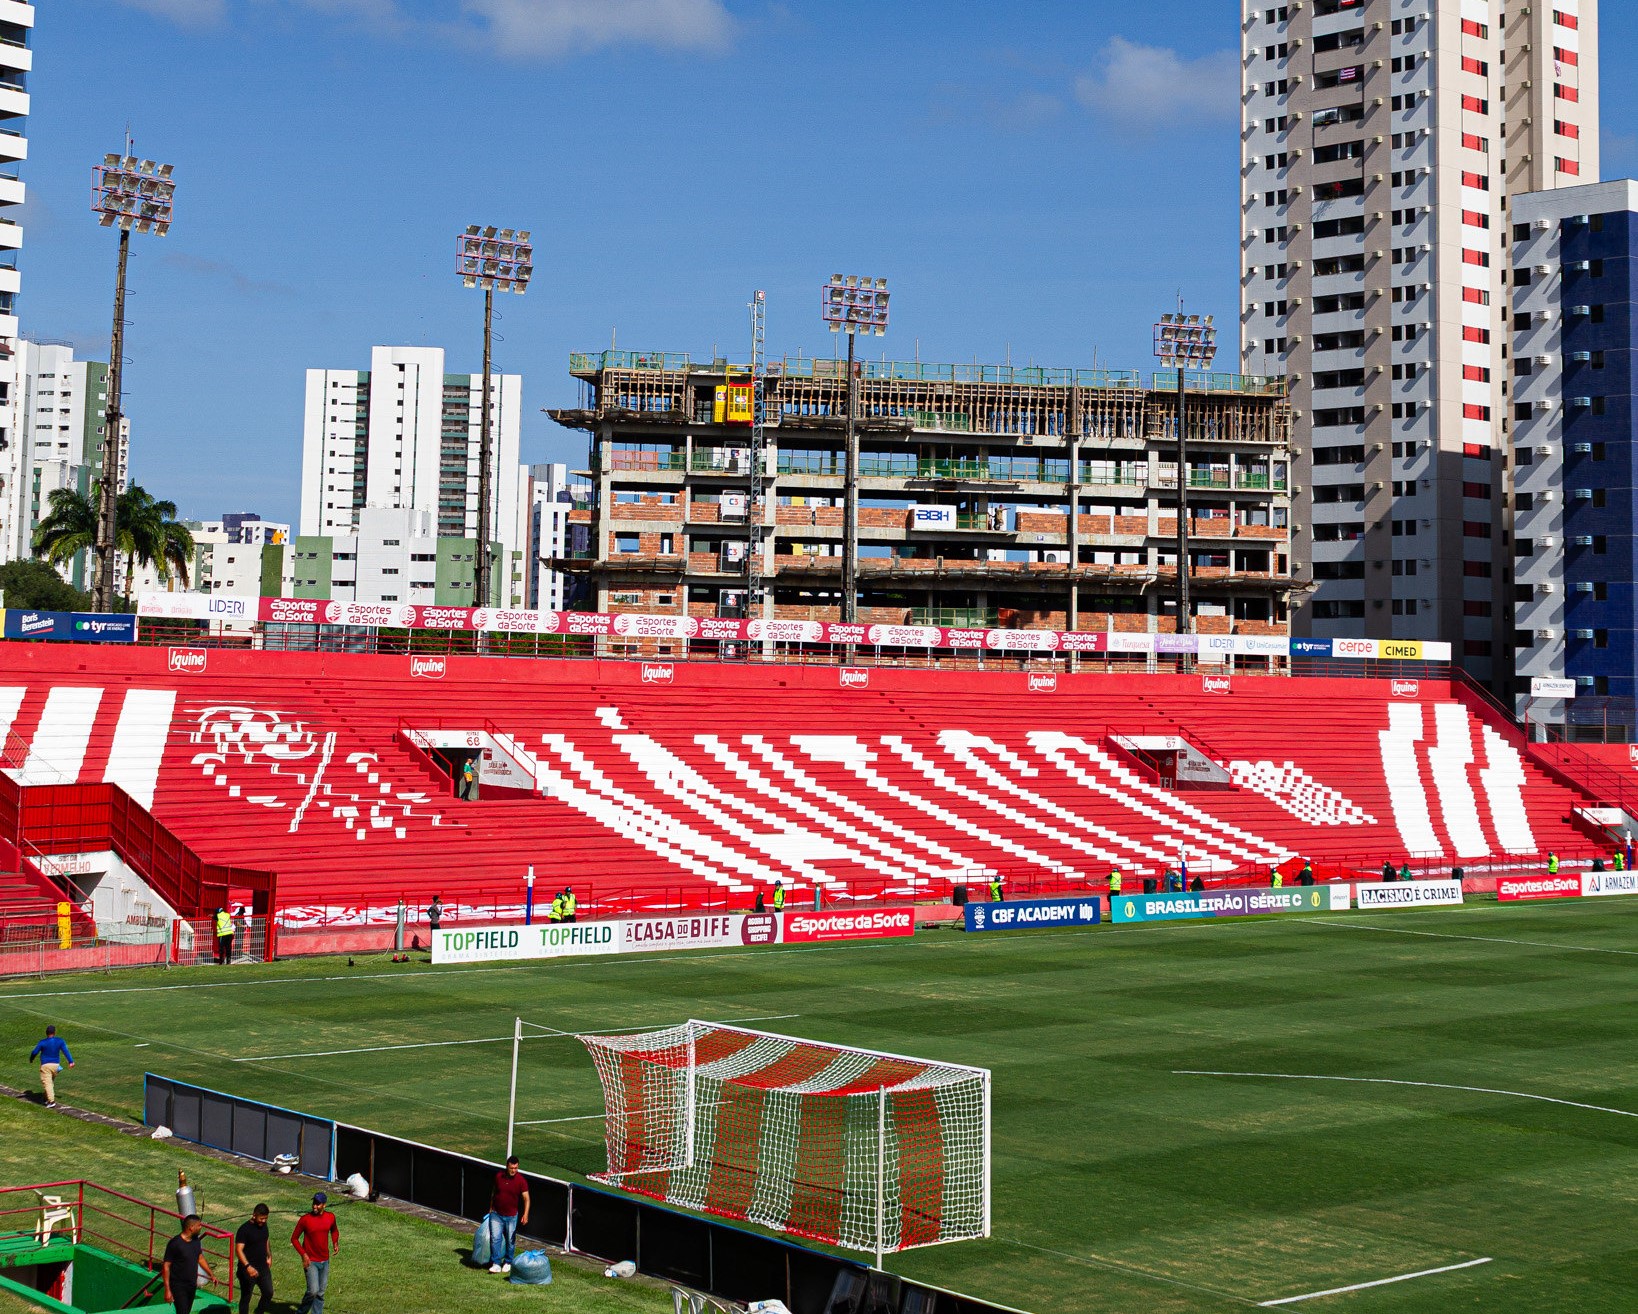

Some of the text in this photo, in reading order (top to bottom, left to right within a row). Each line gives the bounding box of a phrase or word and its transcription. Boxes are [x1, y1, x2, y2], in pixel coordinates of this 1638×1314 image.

[916, 509, 949, 521] BBH
[209, 599, 245, 614] LIDERI
[271, 599, 317, 611] Esportes
[347, 604, 391, 615] Esportes
[22, 613, 39, 624] Boris
[422, 607, 467, 619] Esportes
[496, 610, 539, 621] Esportes
[567, 614, 610, 625] Esportes
[22, 618, 54, 632] Berenstein
[91, 620, 107, 634] tyr
[636, 617, 677, 626] Esportes
[700, 619, 740, 629] Esportes
[766, 622, 803, 631] Esportes
[828, 624, 865, 634] Esportes
[888, 627, 924, 637] Esportes
[948, 629, 984, 639] Esportes
[1005, 632, 1040, 641] Esportes
[1061, 632, 1097, 642] Esportes
[1209, 638, 1234, 649] LIDERI
[1303, 642, 1314, 652] tyr
[1339, 641, 1373, 655] cerpe
[1385, 646, 1417, 656] CIMED
[171, 651, 205, 668] Iquine
[413, 658, 444, 674] Iquine
[644, 664, 672, 680] Iquine
[842, 670, 868, 685] Iquine
[1030, 675, 1055, 690] Iquine
[1205, 677, 1229, 692] Iquine
[1393, 681, 1418, 696] Iquine
[1362, 885, 1459, 904] RACISMO É CRIME!
[1500, 880, 1543, 896] Esportes
[1145, 893, 1302, 915] BRASILEIRÃO SÉRIE C
[992, 905, 1076, 923] CBF ACADEMY
[634, 921, 675, 941] CASA
[690, 917, 730, 938] BIFE
[790, 916, 854, 935] Esportes
[443, 930, 519, 951] TOPFIELD
[540, 926, 612, 946] TOPFIELD
